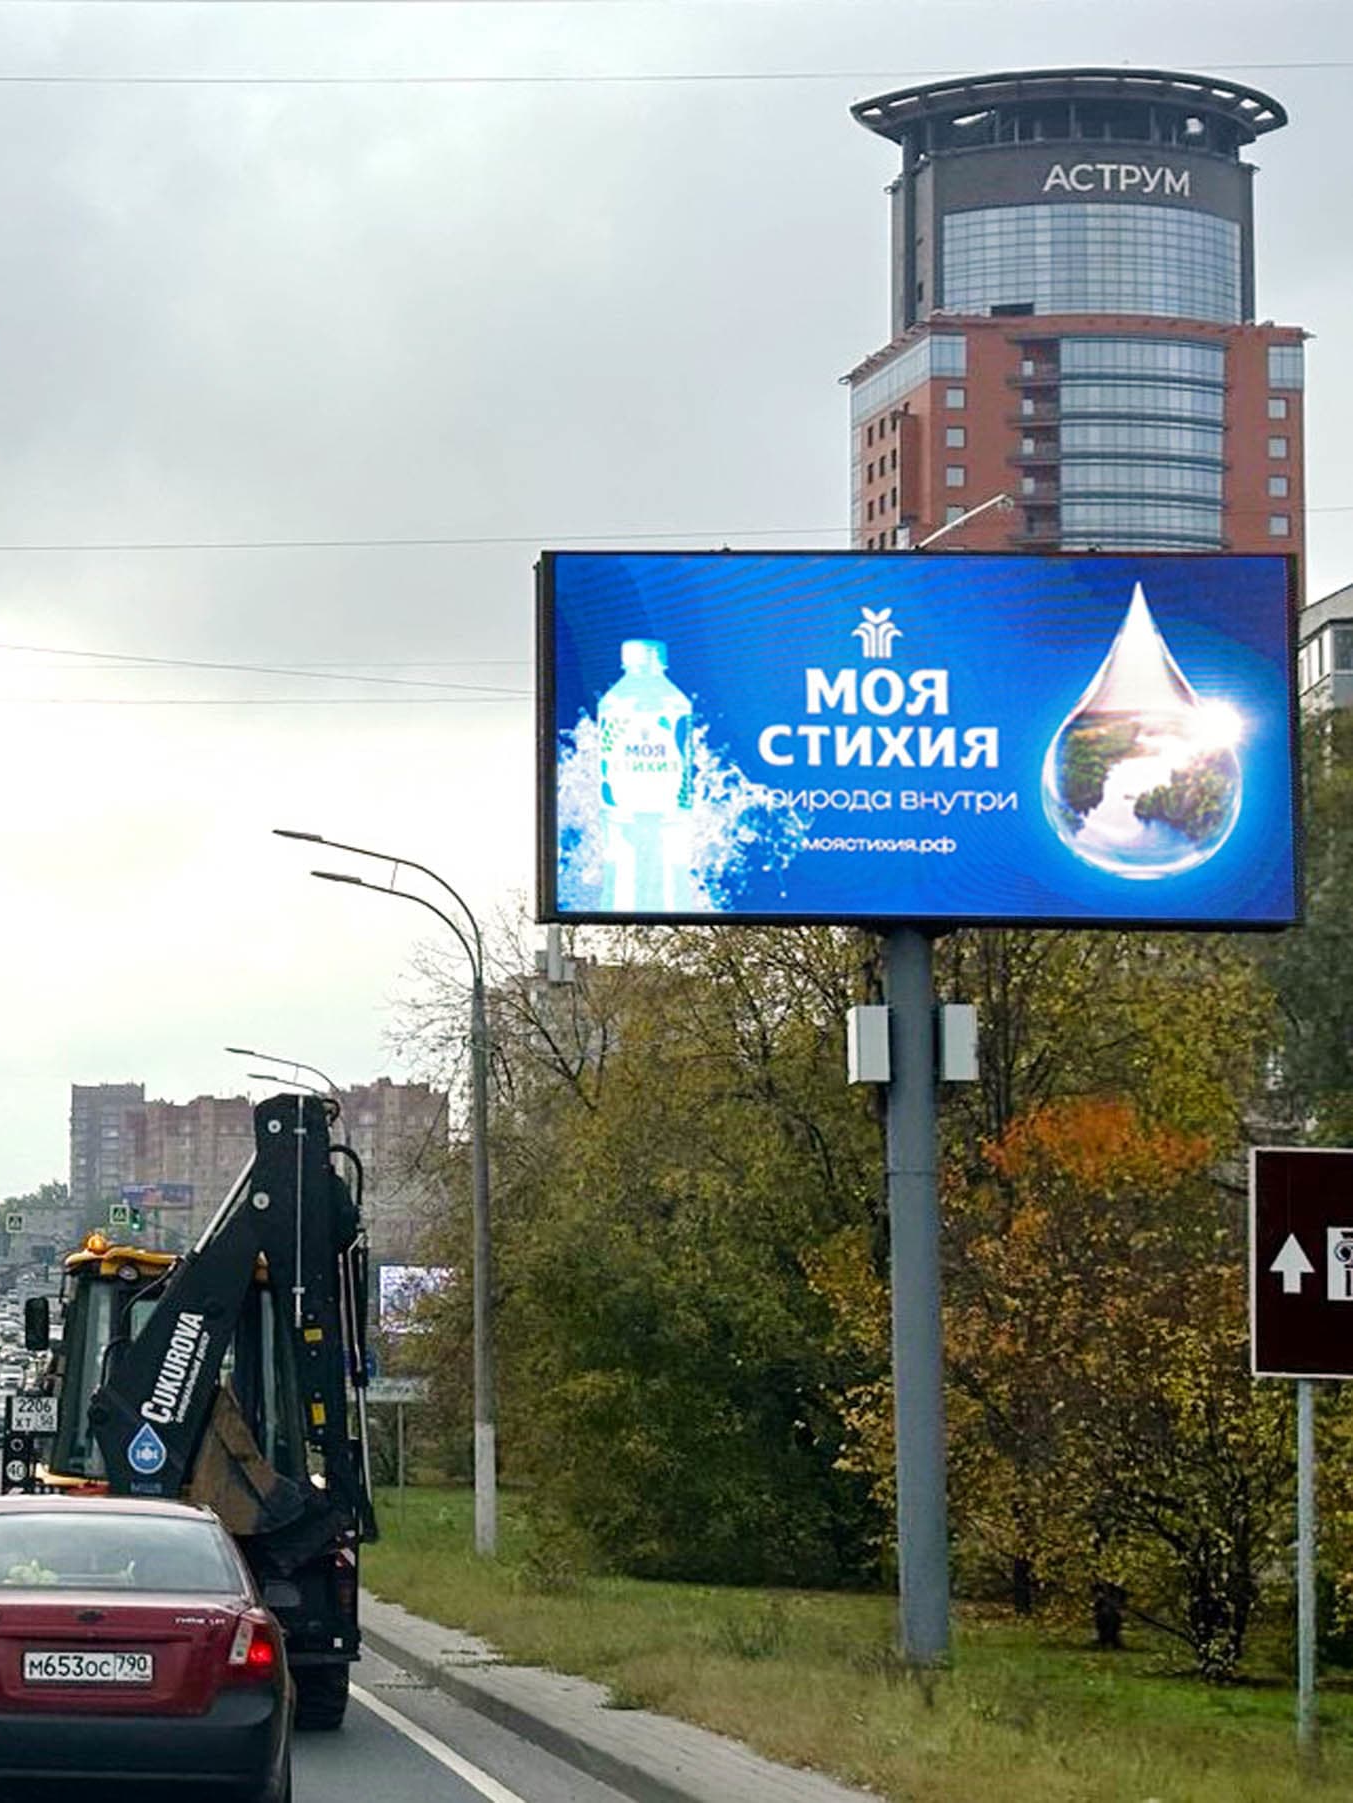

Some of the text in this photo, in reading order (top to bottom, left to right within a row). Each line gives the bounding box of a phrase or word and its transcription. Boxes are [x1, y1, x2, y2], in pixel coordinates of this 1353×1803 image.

[1042, 163, 1190, 197] АСТРУМ
[805, 667, 949, 716] МОЯ
[757, 724, 999, 768] СТИХИЯ
[899, 789, 1018, 815] внутри
[18, 1398, 52, 1413] 2206
[29, 1654, 148, 1677] М653ОС 790
